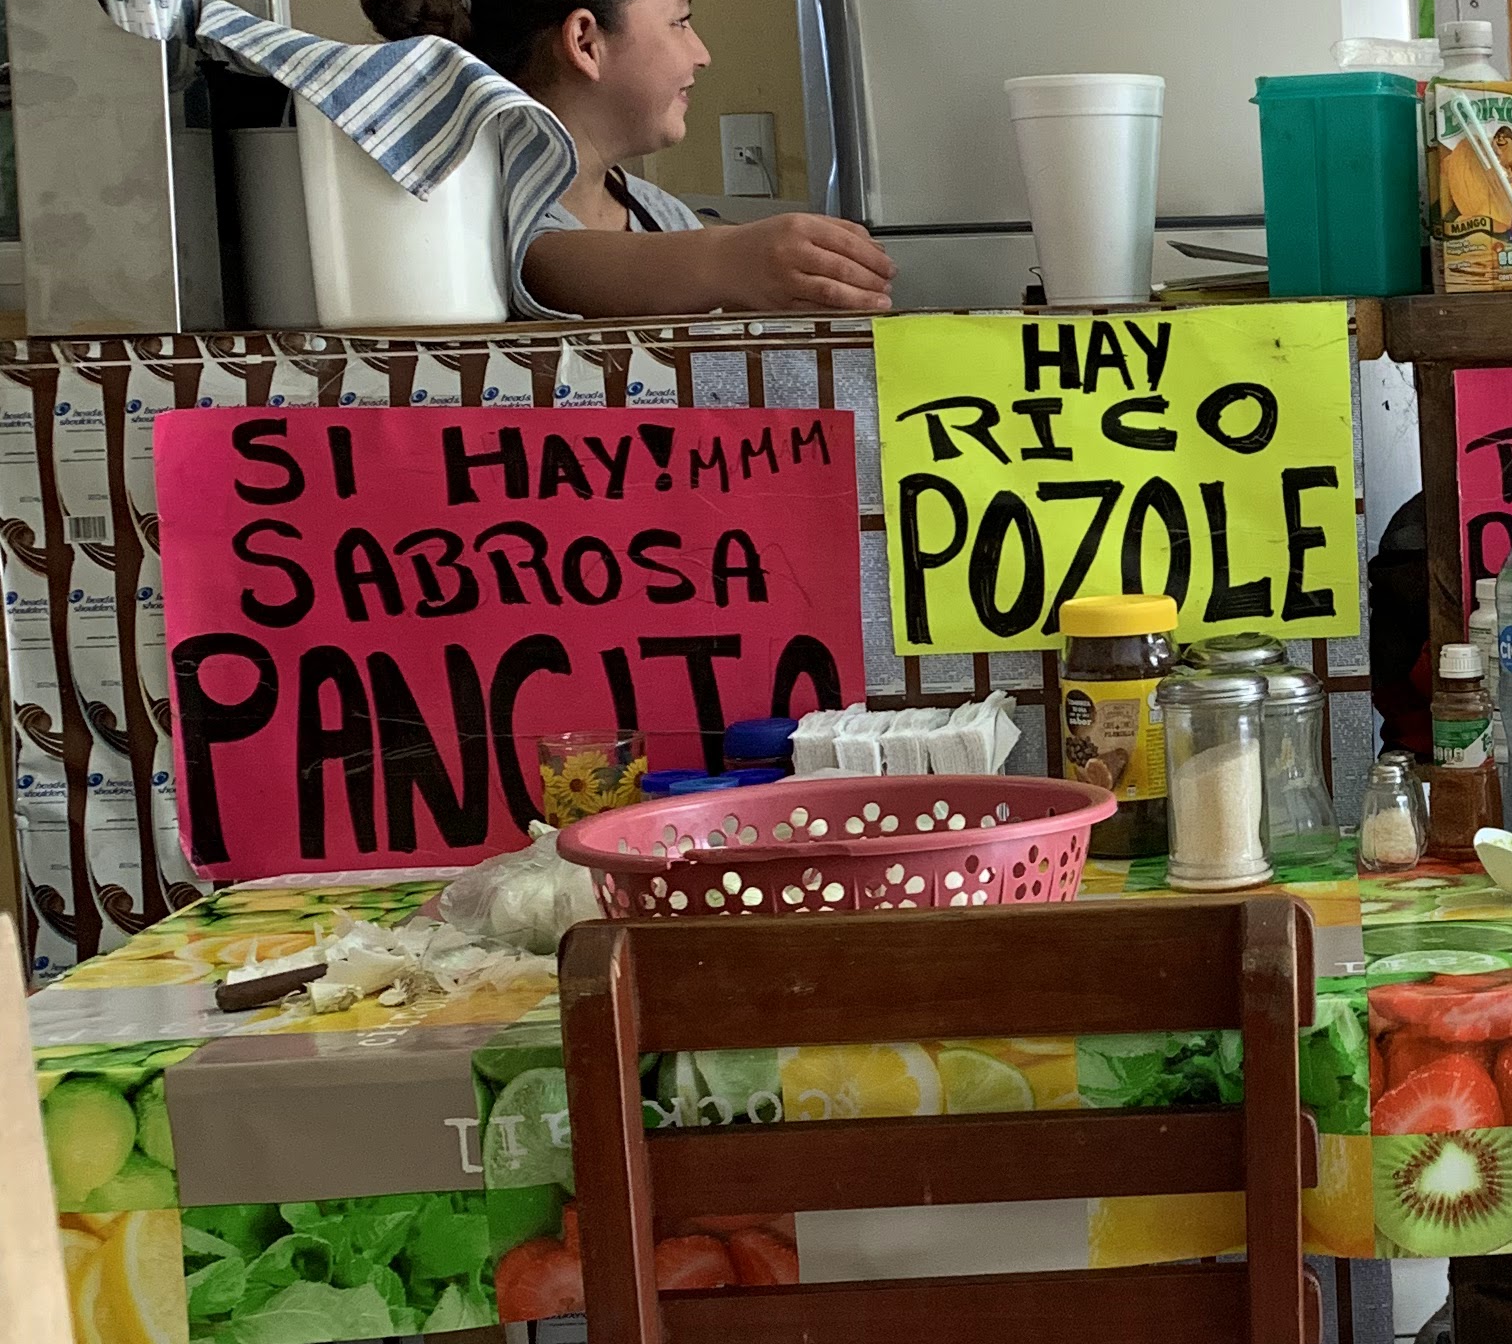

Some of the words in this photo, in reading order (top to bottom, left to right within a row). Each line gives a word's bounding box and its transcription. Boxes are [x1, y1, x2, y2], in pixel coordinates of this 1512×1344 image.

[1451, 218, 1487, 234] MANGO
[1022, 320, 1171, 393] HAY
[231, 417, 358, 506] SI
[442, 422, 676, 505] HAY!
[895, 382, 1279, 465] RICO
[231, 518, 770, 628] SABROSA
[898, 466, 1339, 645] POZOLE
